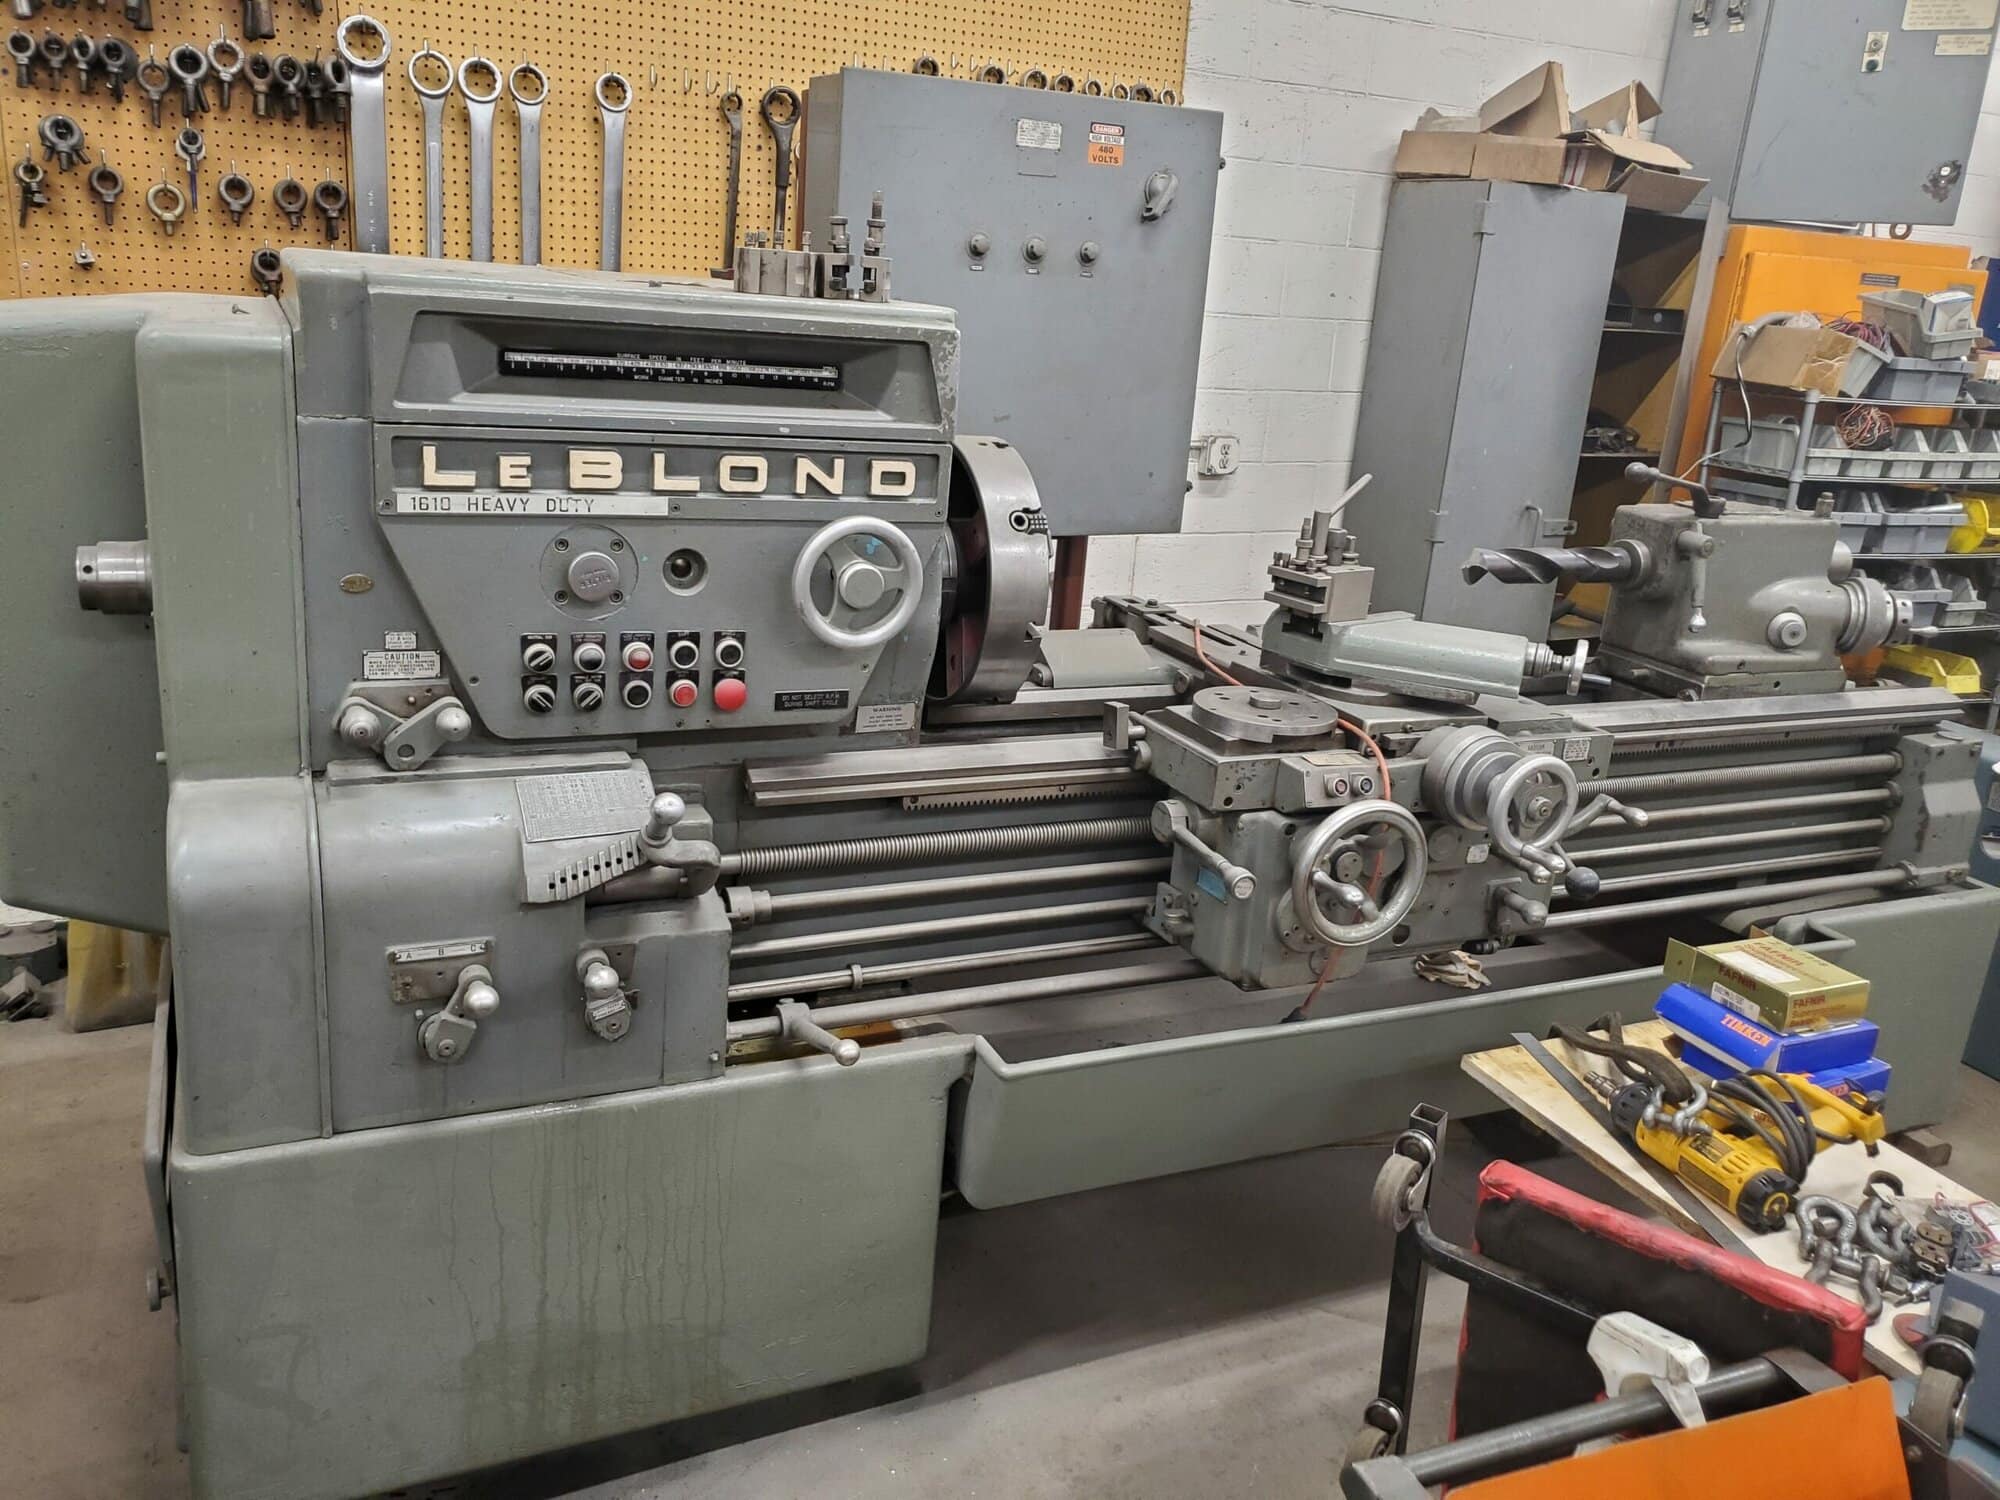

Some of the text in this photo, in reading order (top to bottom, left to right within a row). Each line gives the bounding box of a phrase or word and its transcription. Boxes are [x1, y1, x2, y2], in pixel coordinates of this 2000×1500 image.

[1099, 145, 1114, 154] 480
[1092, 153, 1119, 164] VOLTS
[411, 496, 594, 513] 1610 HEAVY DUTY
[1753, 942, 1804, 966] FAFNIR
[1718, 963, 1757, 991] FAFNIR
[1794, 995, 1826, 1007] FAFNIR
[1720, 1013, 1773, 1048] TIMKEN
